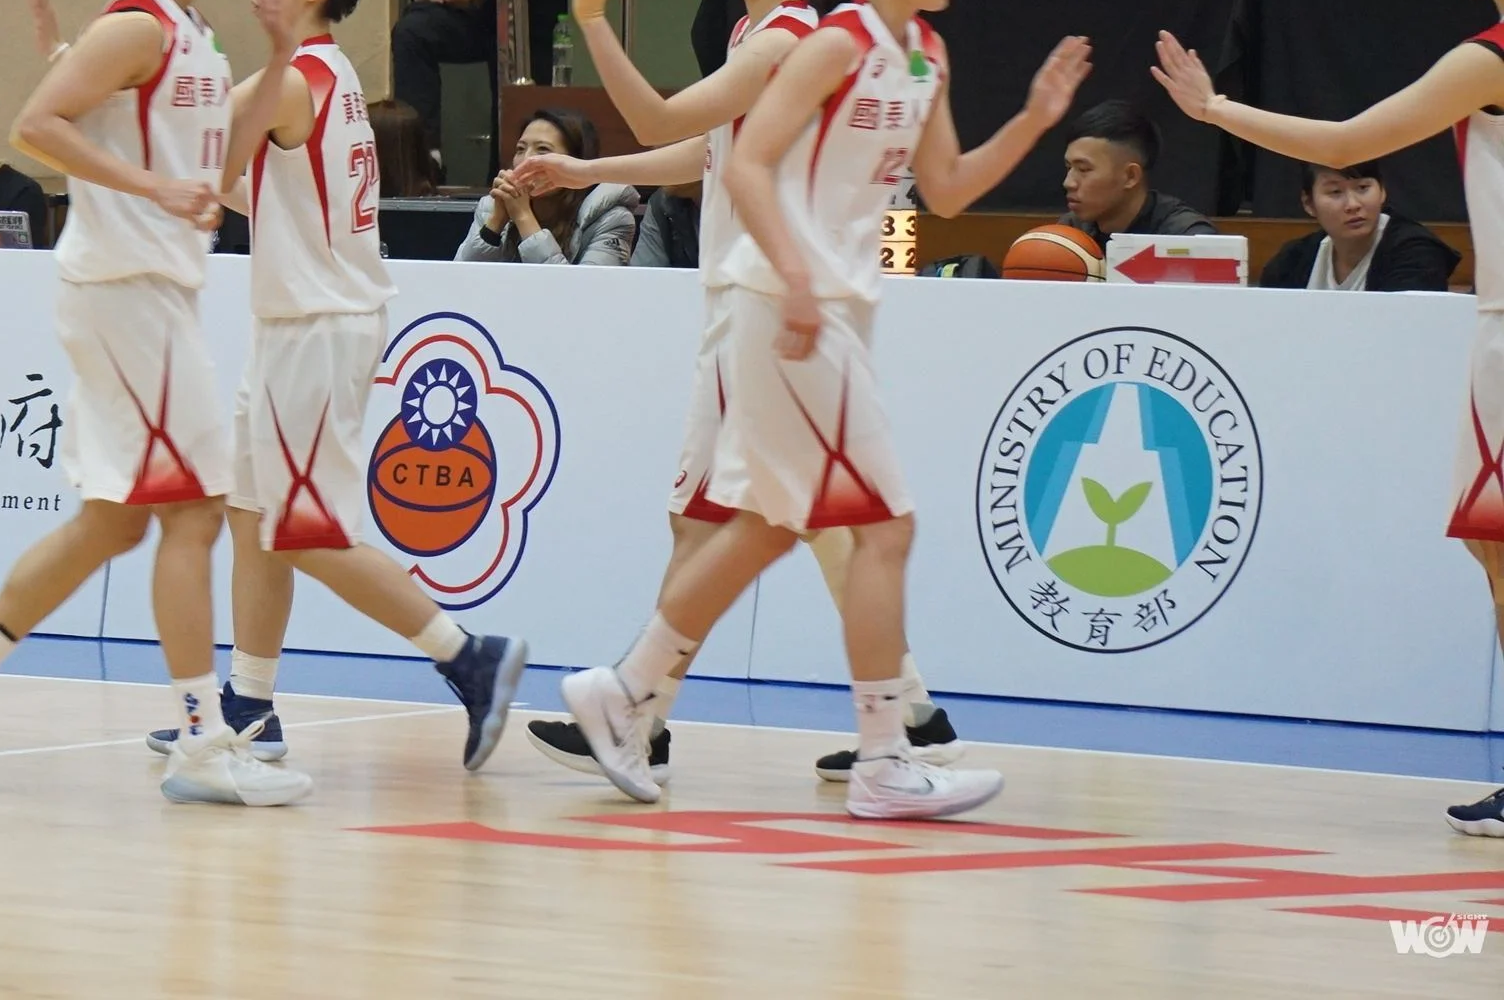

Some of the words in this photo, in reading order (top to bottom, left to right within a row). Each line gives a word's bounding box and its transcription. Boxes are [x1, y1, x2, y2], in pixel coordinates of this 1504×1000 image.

[392, 462, 474, 488] CTBA
[990, 362, 1072, 575] MINISTRY
[1083, 343, 1134, 380] OF
[1144, 346, 1249, 583] EDUCATION
[1028, 580, 1177, 647] 教育部
